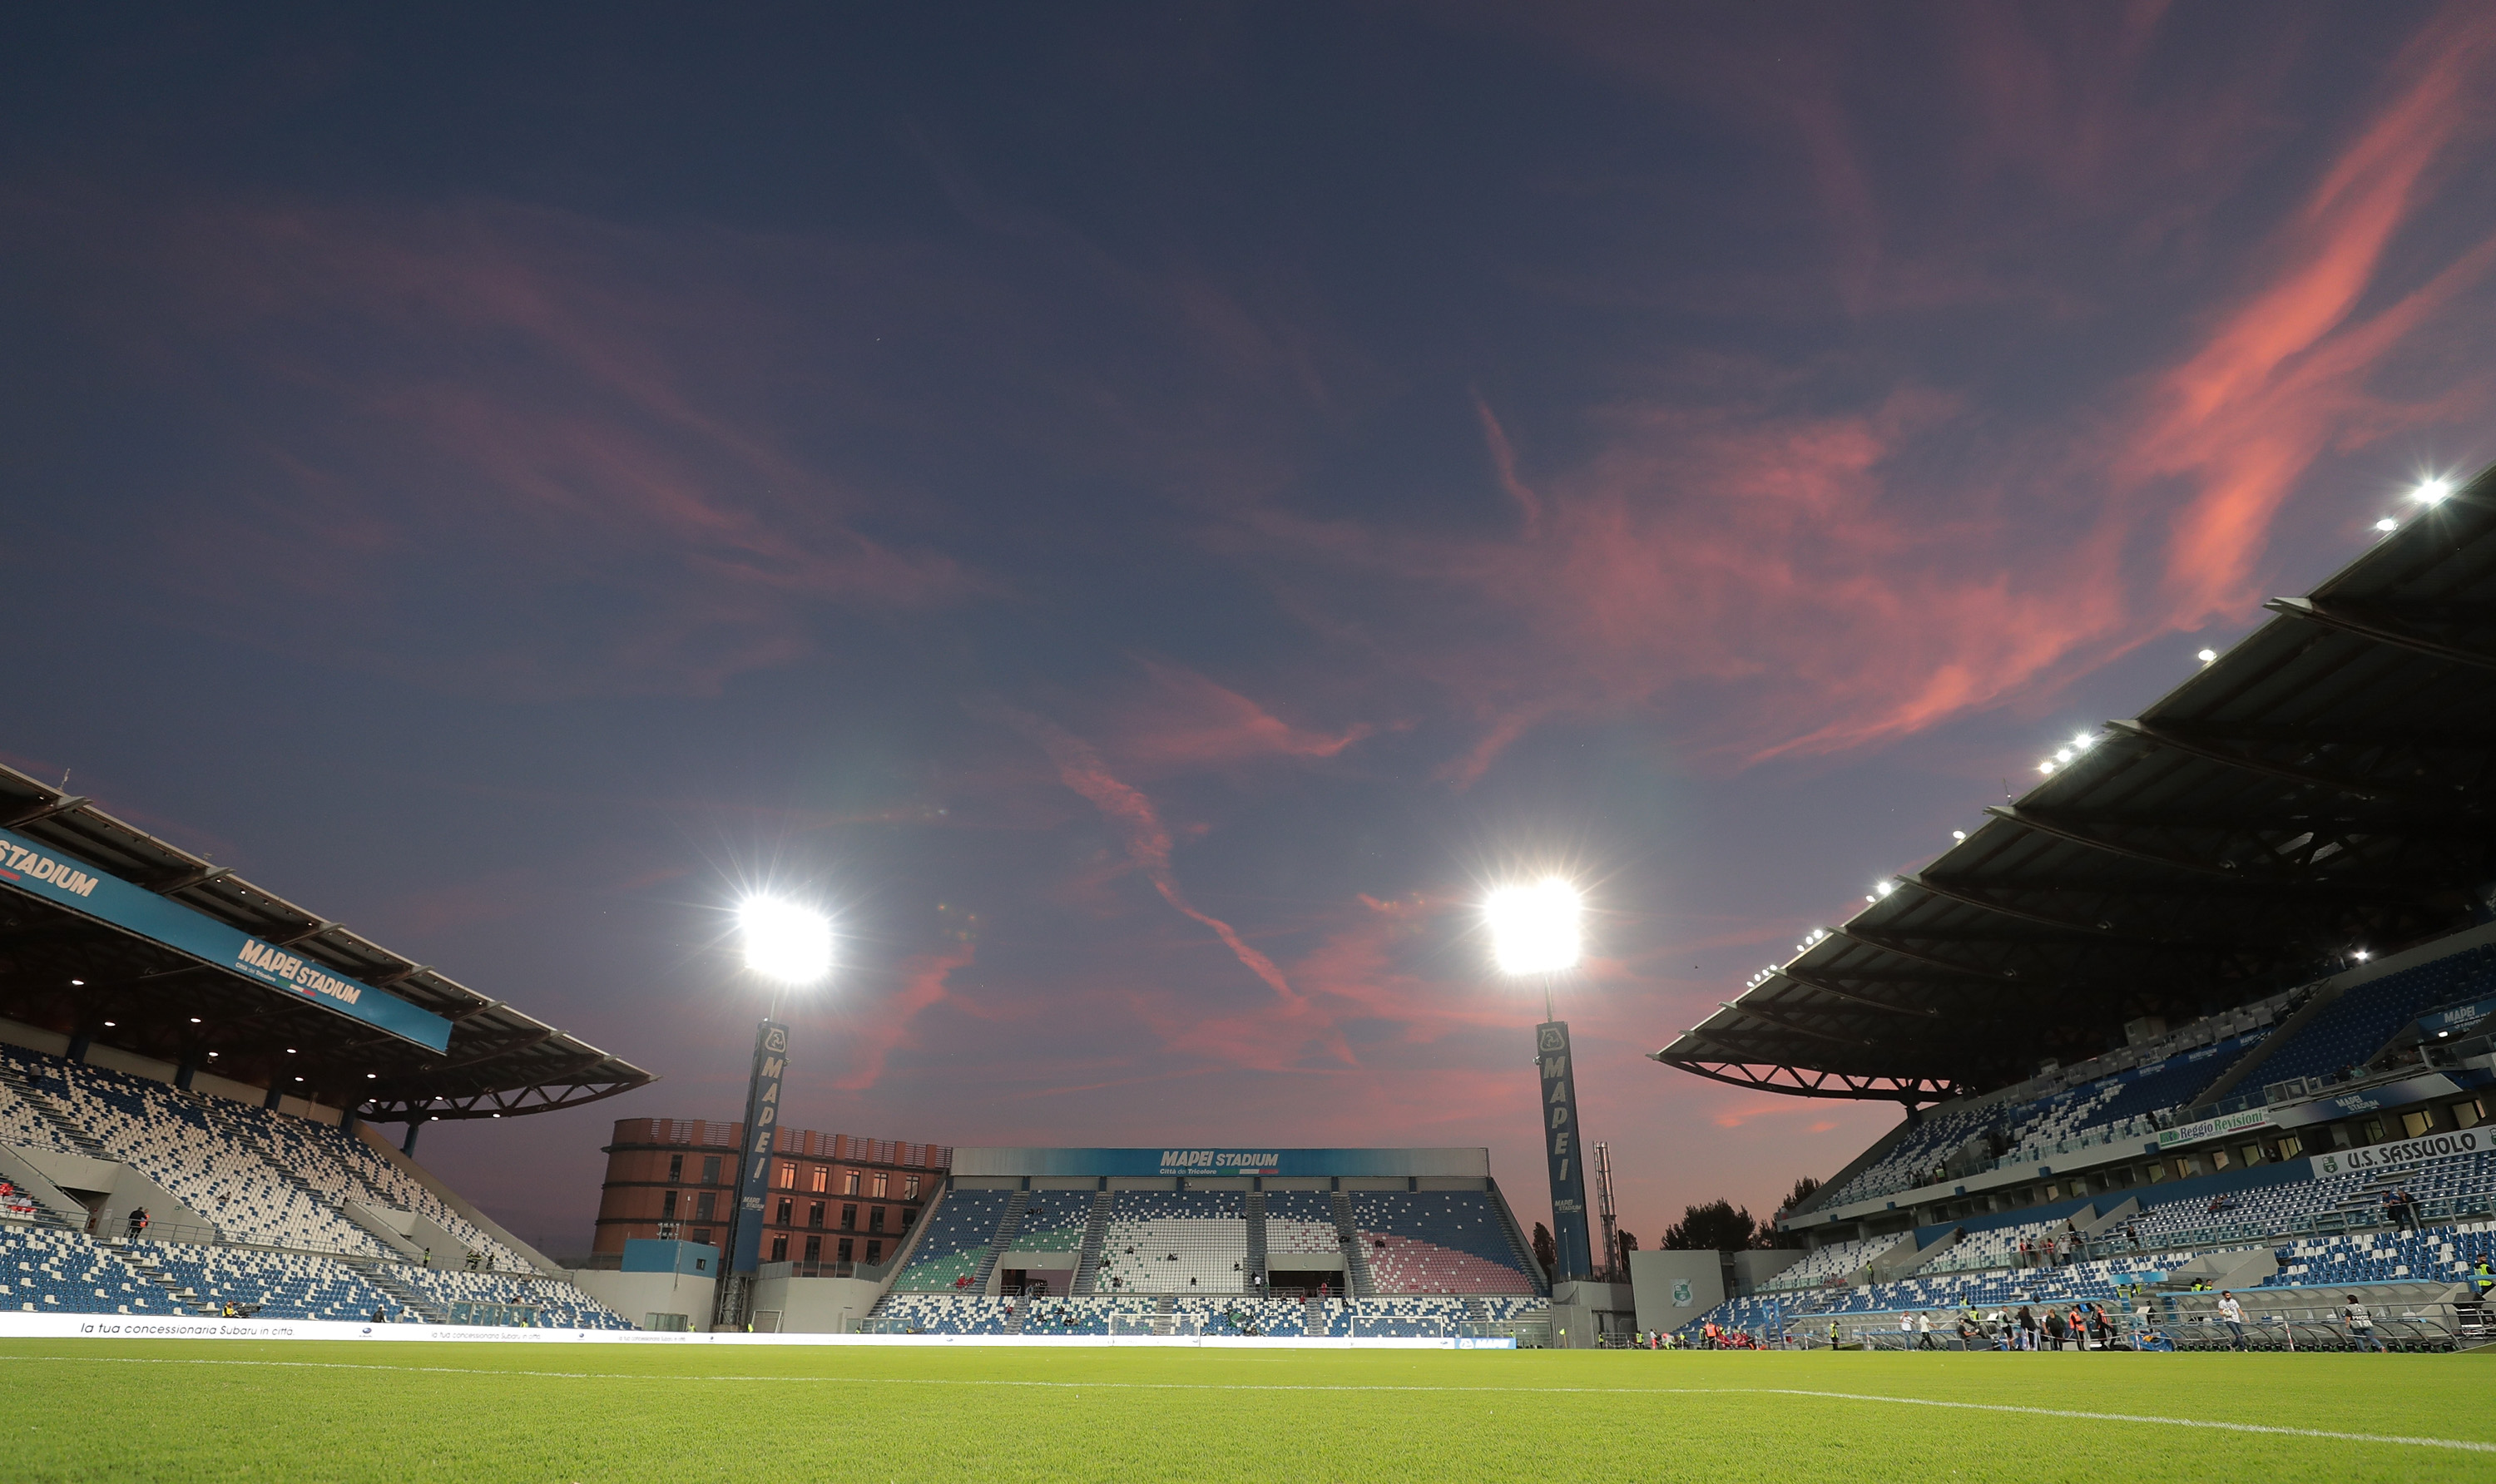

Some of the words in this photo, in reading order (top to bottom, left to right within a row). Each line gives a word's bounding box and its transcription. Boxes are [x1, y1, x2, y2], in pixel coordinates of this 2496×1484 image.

[0, 840, 98, 897] STADIUM
[238, 939, 303, 980] MAPEI
[296, 967, 361, 1005] STADIUM
[2444, 1006, 2475, 1023] MAPEI
[2335, 1096, 2363, 1107] MAPEI
[2348, 1100, 2380, 1111] STADIUM
[753, 1056, 783, 1180] MAPEI
[1543, 1056, 1569, 1181] MAPEI
[2180, 1122, 2213, 1139] Reggio
[2214, 1110, 2262, 1131] Revisioni
[1161, 1151, 1215, 1166] MAPEI
[1216, 1154, 1279, 1166] STADIUM
[2347, 1150, 2377, 1169] U.S.
[2379, 1133, 2476, 1165] SASSUOLO
[81, 1323, 94, 1333] la
[99, 1323, 120, 1333] tua
[124, 1324, 216, 1335] concessionaria
[220, 1325, 257, 1335] Subaru
[260, 1327, 269, 1335] in
